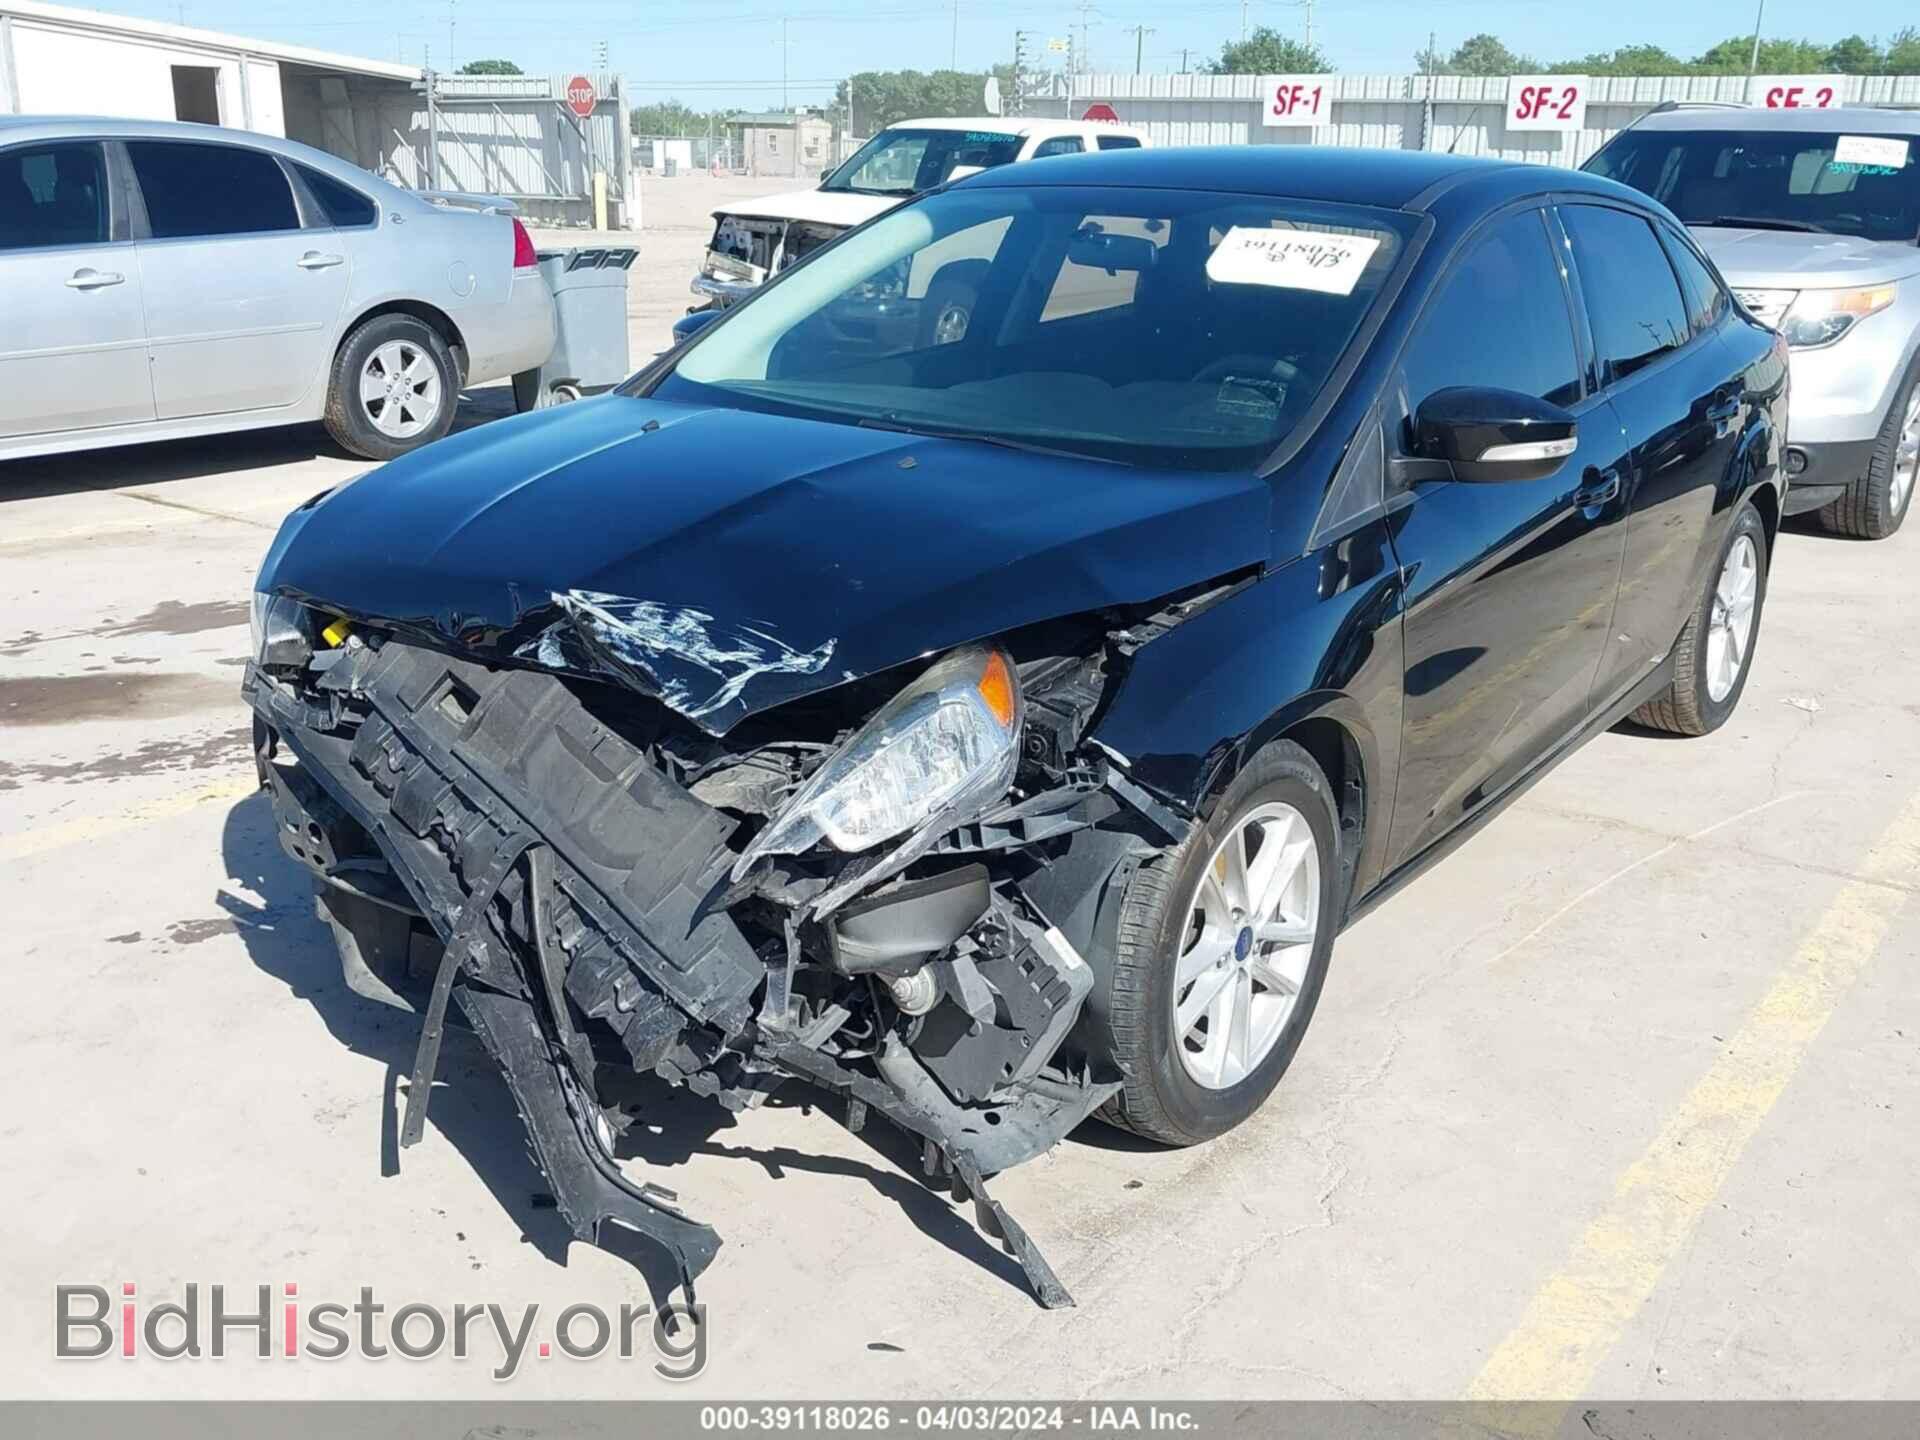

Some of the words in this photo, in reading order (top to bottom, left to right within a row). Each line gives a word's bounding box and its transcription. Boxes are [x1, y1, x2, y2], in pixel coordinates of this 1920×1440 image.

[568, 88, 593, 104] STOP
[1273, 84, 1322, 115] SF-1
[1516, 86, 1577, 119] SF-2
